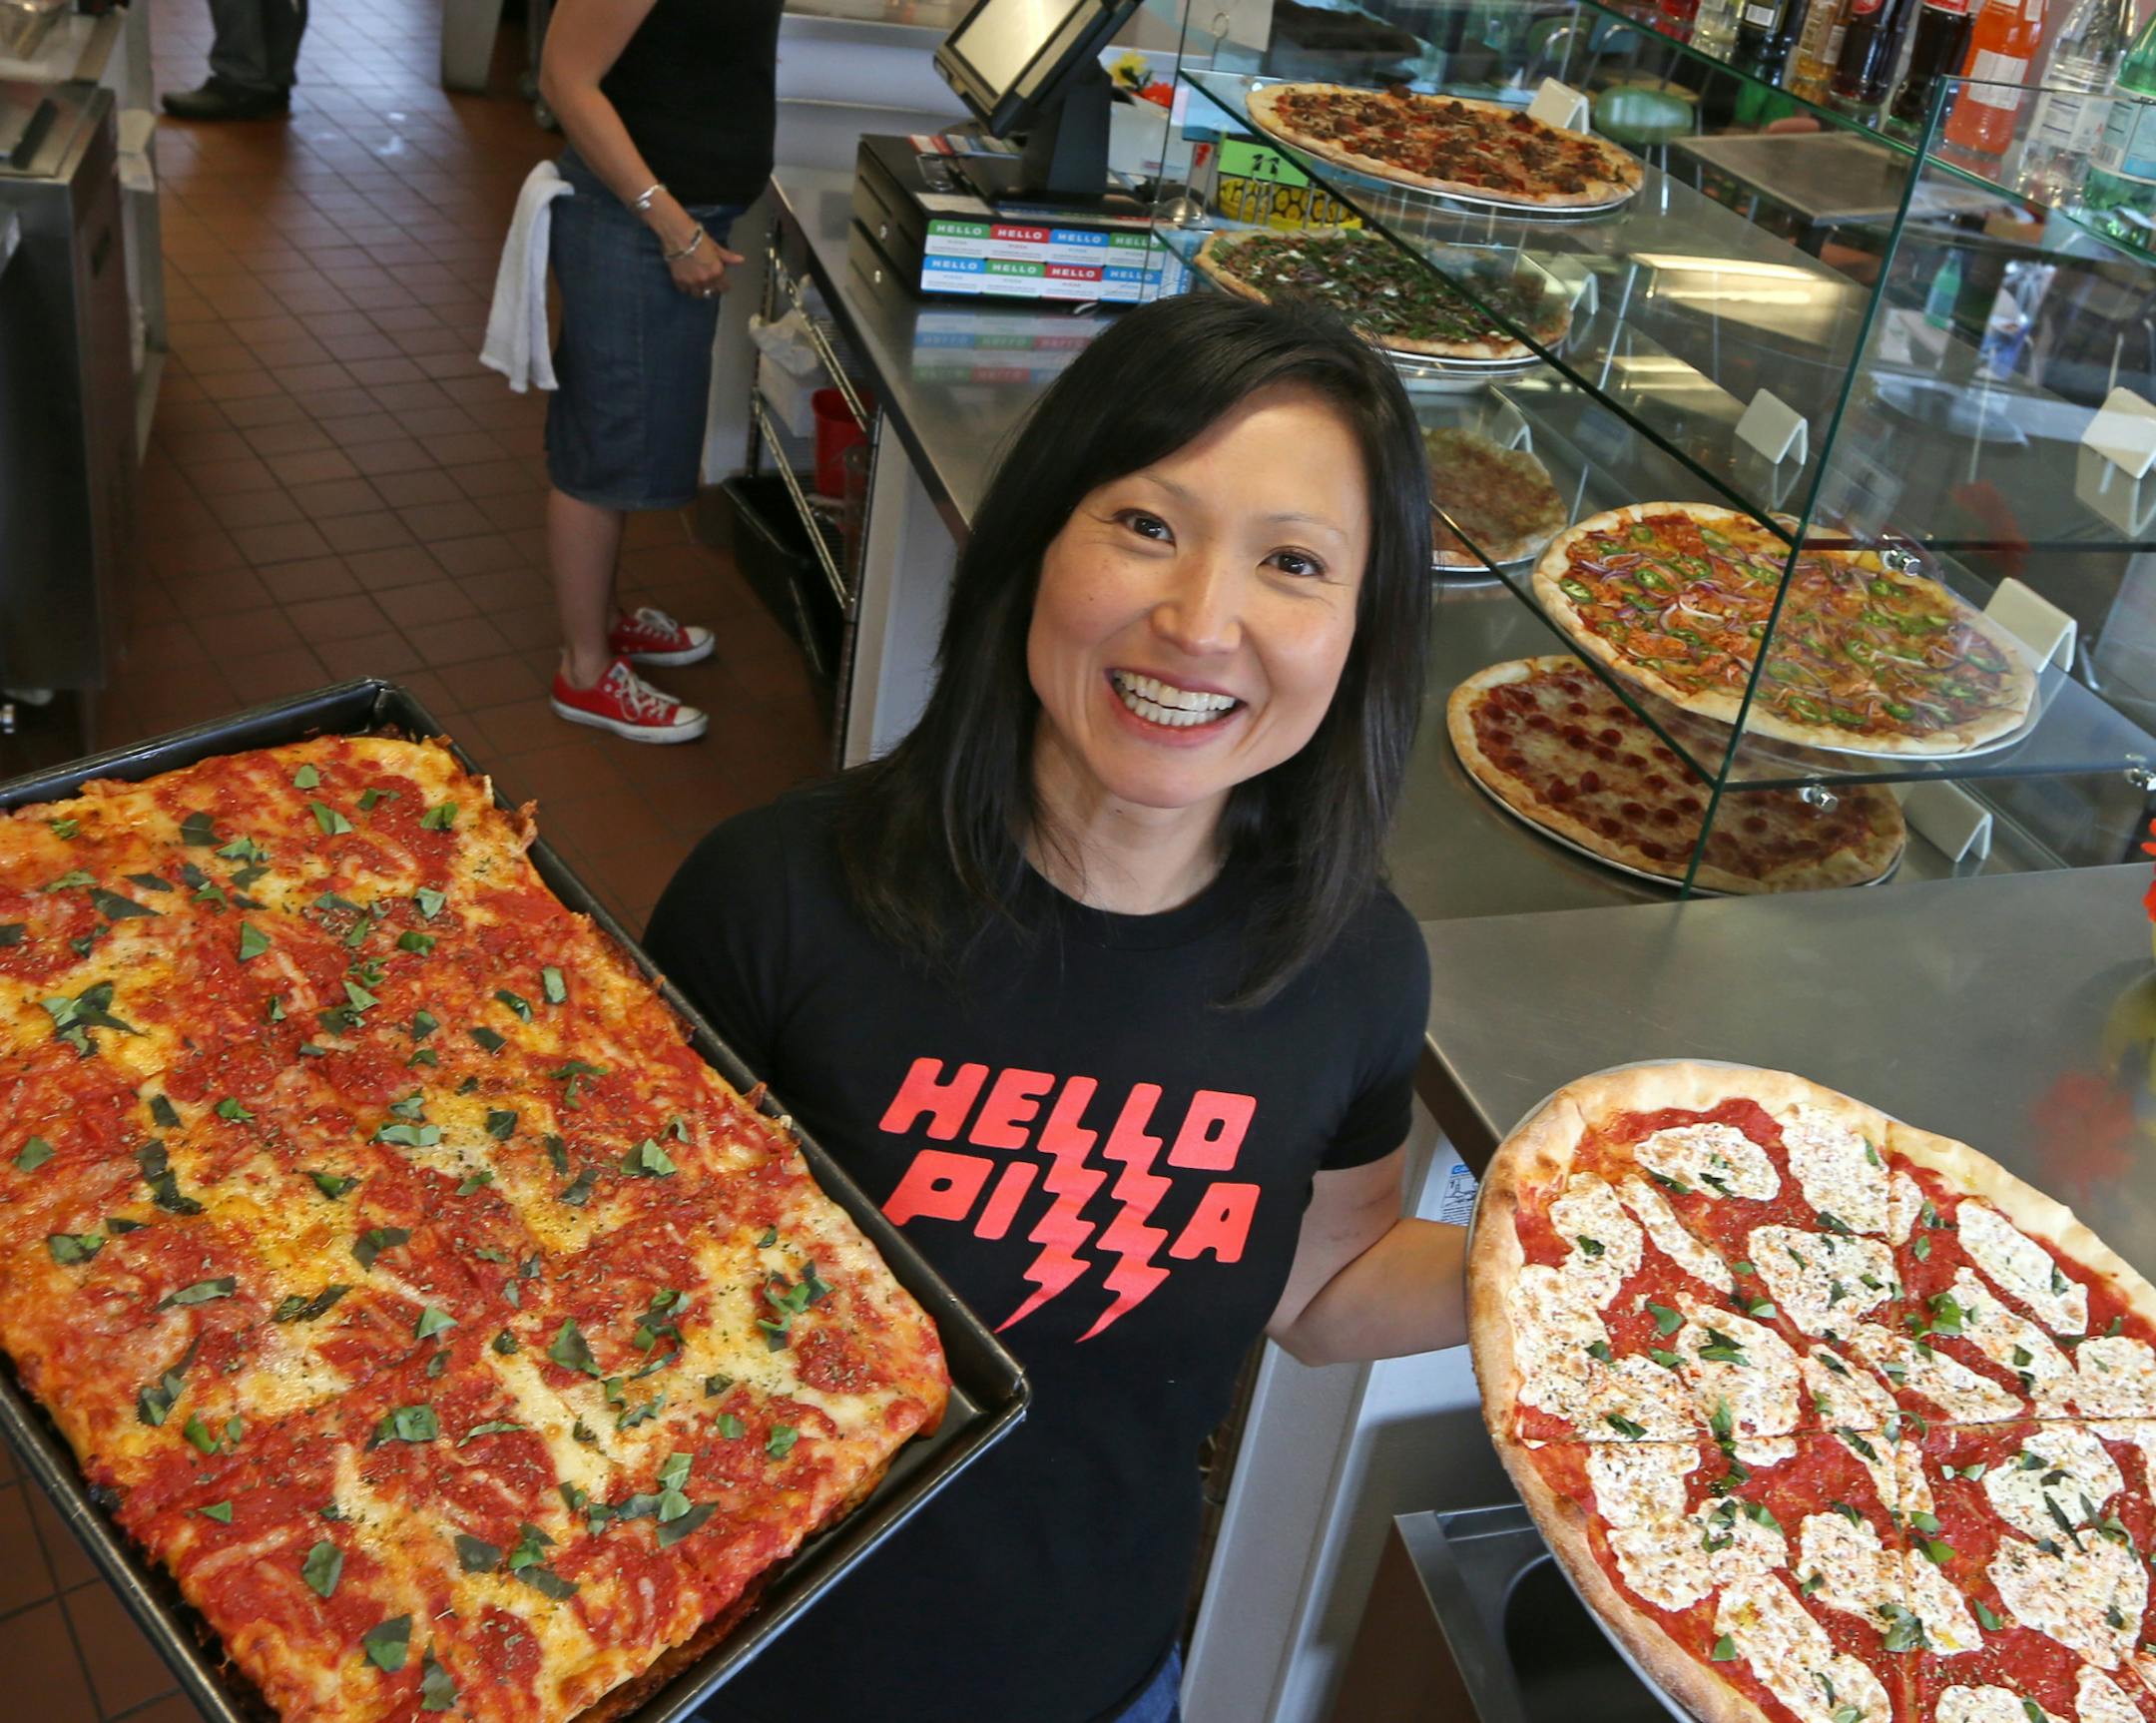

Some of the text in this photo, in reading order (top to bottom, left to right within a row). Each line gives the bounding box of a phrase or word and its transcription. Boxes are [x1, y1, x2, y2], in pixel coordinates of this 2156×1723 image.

[936, 224, 982, 236] HELLO
[997, 229, 1043, 240] HELLO
[1058, 233, 1102, 244] HELLO
[1115, 237, 1159, 249] HELLO
[931, 260, 977, 271] HELLO
[992, 264, 1037, 275] HELLO
[1051, 268, 1096, 279] HELLO
[1110, 270, 1154, 281] HELLO
[878, 1057, 1258, 1172] HELLO
[880, 1149, 1261, 1343] PIZZA
